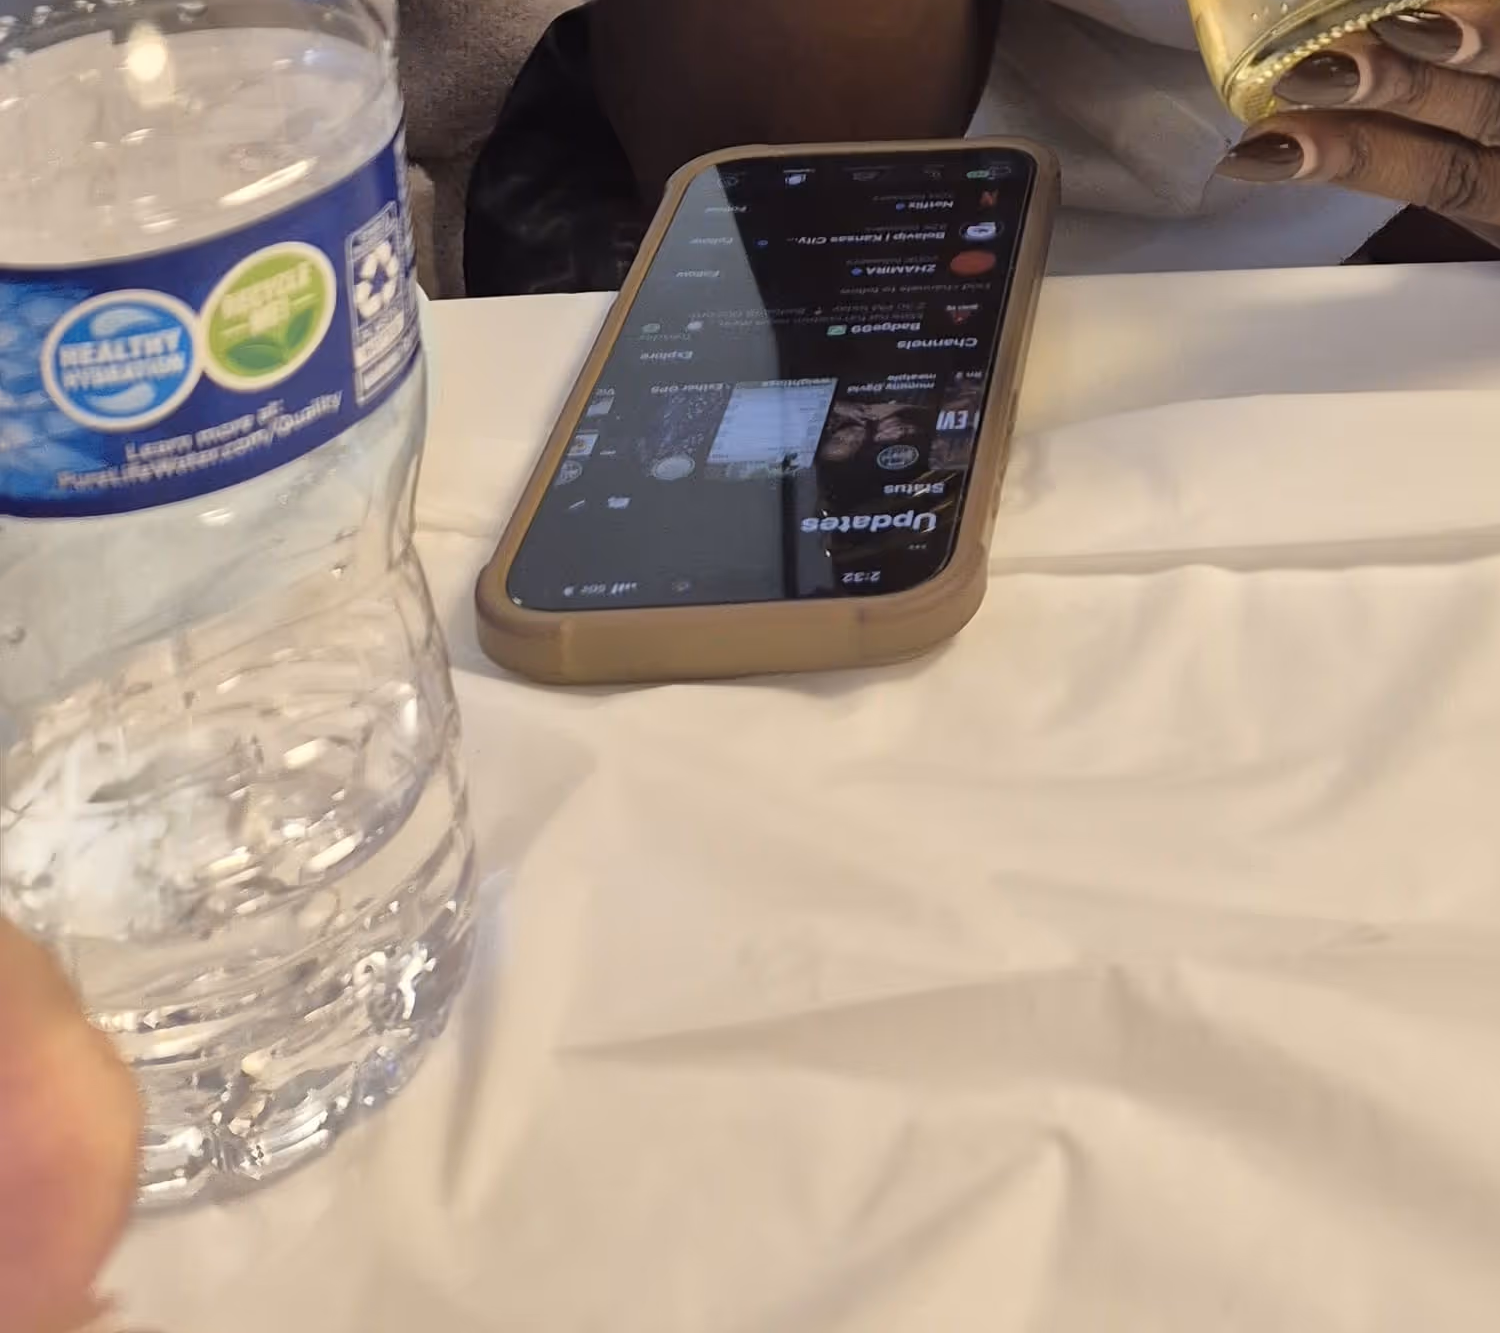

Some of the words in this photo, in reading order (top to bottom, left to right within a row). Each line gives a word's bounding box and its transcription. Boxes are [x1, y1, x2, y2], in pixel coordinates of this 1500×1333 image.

[908, 200, 954, 210] Netflix
[830, 234, 883, 243] Kansas
[894, 230, 945, 240] Bolavip
[60, 326, 184, 371] HEALTHY
[896, 337, 978, 350] Channels
[640, 350, 694, 360] Explore
[124, 434, 193, 463] Learn
[196, 413, 256, 448] more
[883, 483, 945, 496] Status
[800, 510, 936, 533] Updates
[841, 571, 880, 582] 2:32
